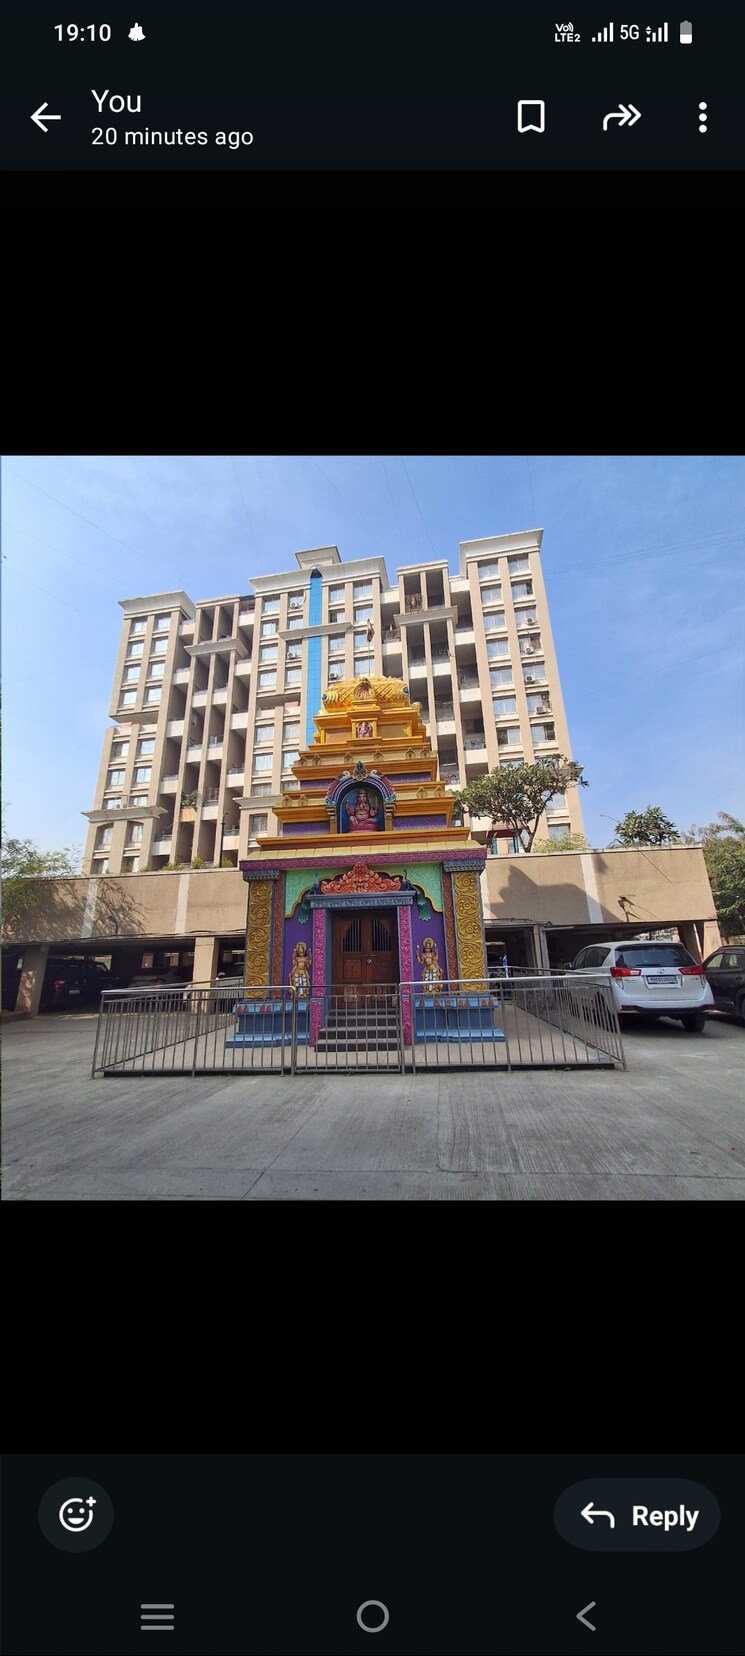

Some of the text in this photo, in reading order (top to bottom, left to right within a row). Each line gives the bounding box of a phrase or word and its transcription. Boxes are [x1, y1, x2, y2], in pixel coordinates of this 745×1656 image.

[54, 23, 111, 42] 19:10
[554, 33, 580, 43] LTE2
[619, 24, 640, 41] 5G
[91, 89, 142, 113] You
[91, 127, 254, 151] 20 minutes ago
[632, 1504, 700, 1532] Reply
